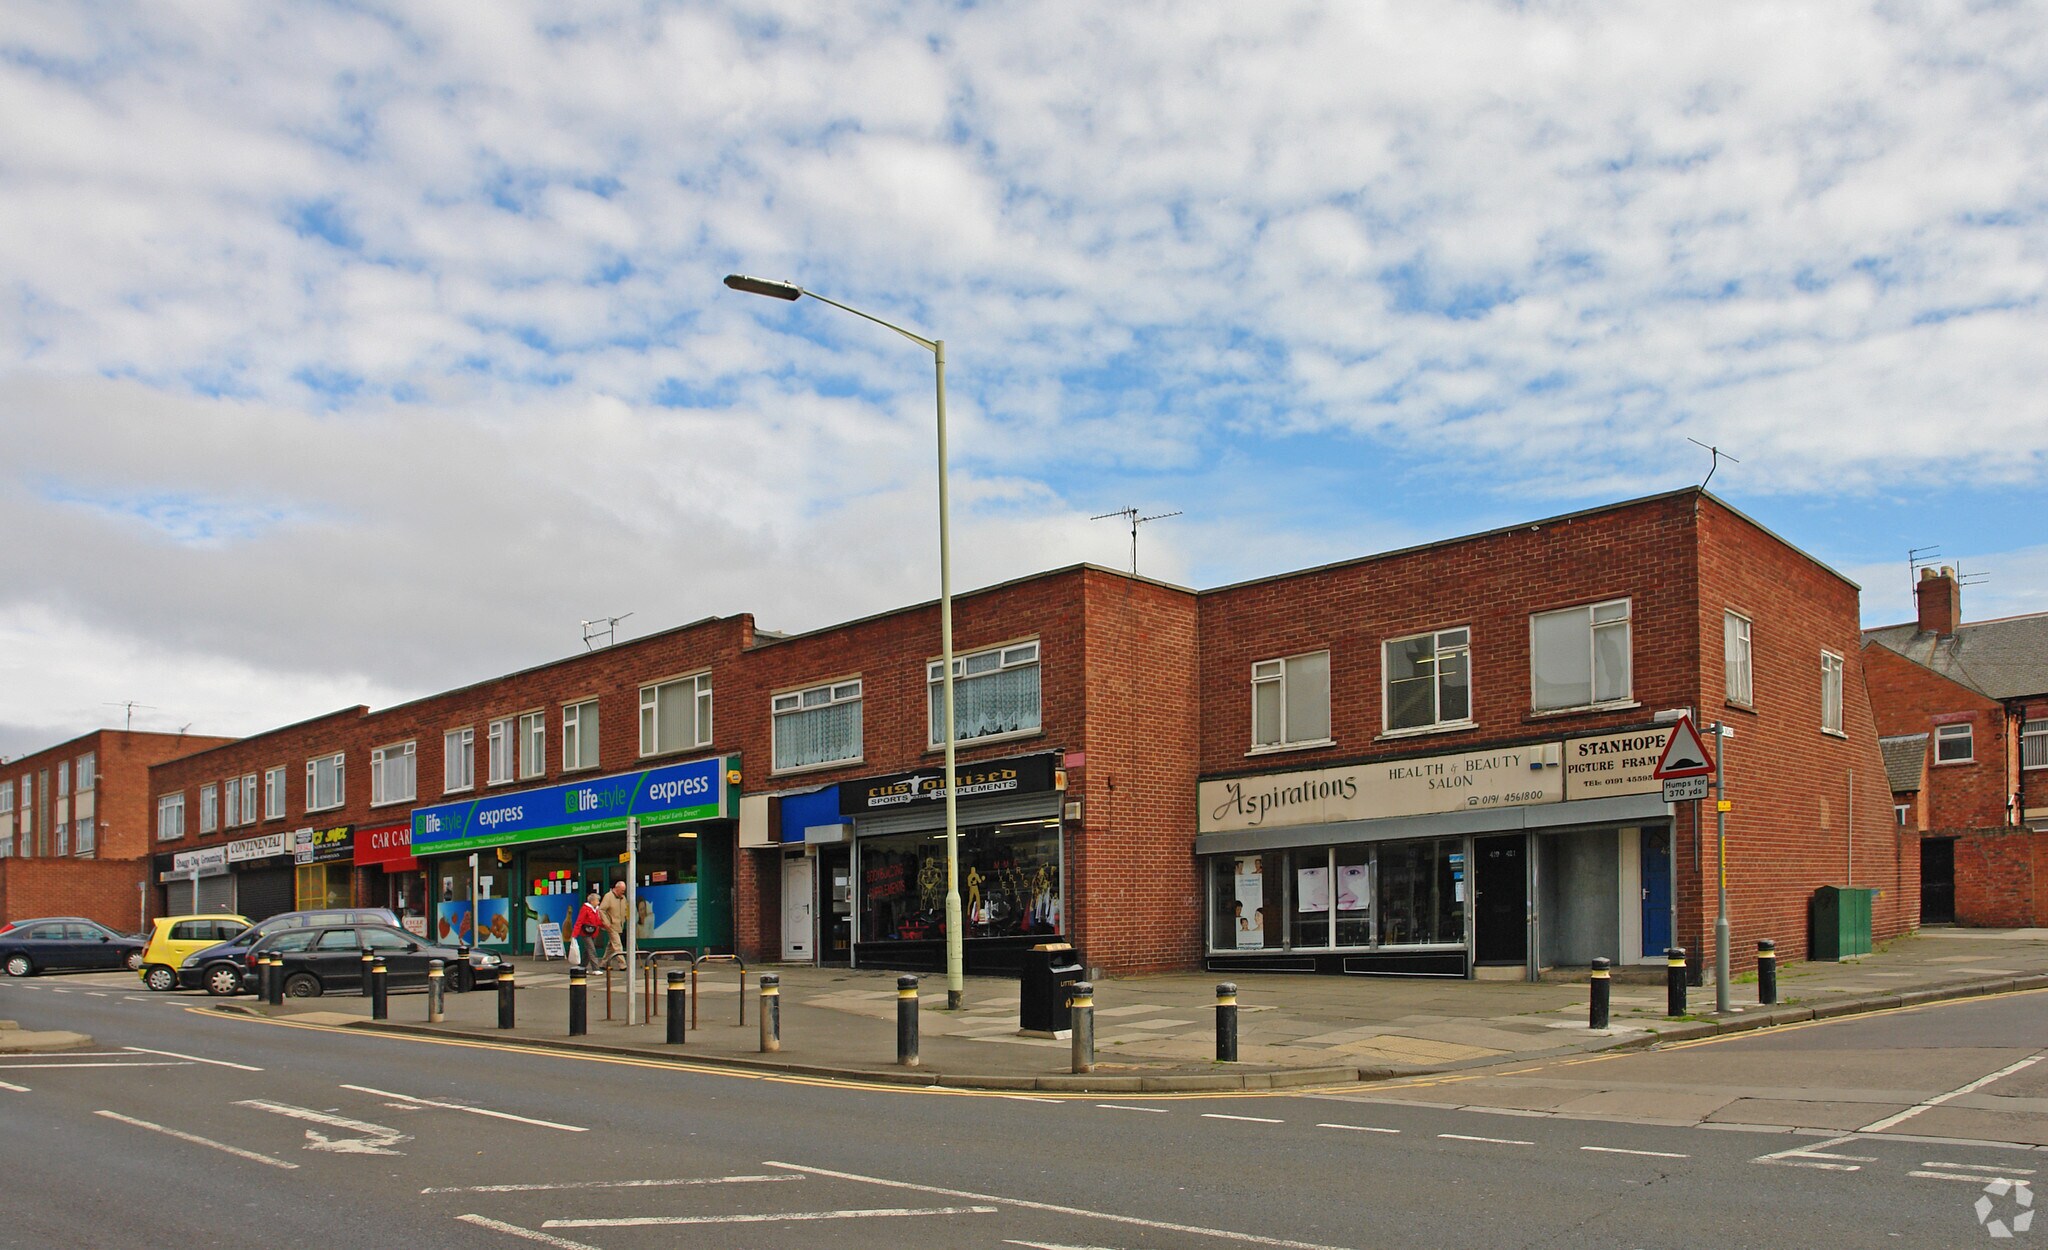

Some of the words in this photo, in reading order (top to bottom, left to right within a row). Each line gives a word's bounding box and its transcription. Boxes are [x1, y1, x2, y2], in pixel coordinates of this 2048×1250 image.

[1578, 734, 1666, 757] STANHOPE
[1389, 763, 1444, 780] HEALTH
[1465, 754, 1522, 772] BEAUTY
[1568, 760, 1615, 774] PICTURE
[1428, 775, 1473, 790] SALON
[1605, 777, 1623, 785] 0191
[1626, 774, 1653, 783] 45595
[1665, 780, 1691, 791] Humps
[1694, 778, 1706, 787] for
[650, 776, 709, 803] express
[870, 794, 908, 805] SPORTS
[935, 780, 1017, 797] SUPLEMENTS
[1482, 794, 1500, 805] 0191
[1504, 790, 1543, 803] 4561800
[1669, 788, 1685, 798] 370
[1688, 787, 1703, 798] yds
[1212, 776, 1358, 826] Aspirations
[479, 806, 524, 829] express
[230, 835, 281, 854] CONTINENTAL
[371, 831, 389, 849] CAR
[245, 849, 266, 858] HAIR
[190, 856, 200, 868] Dog
